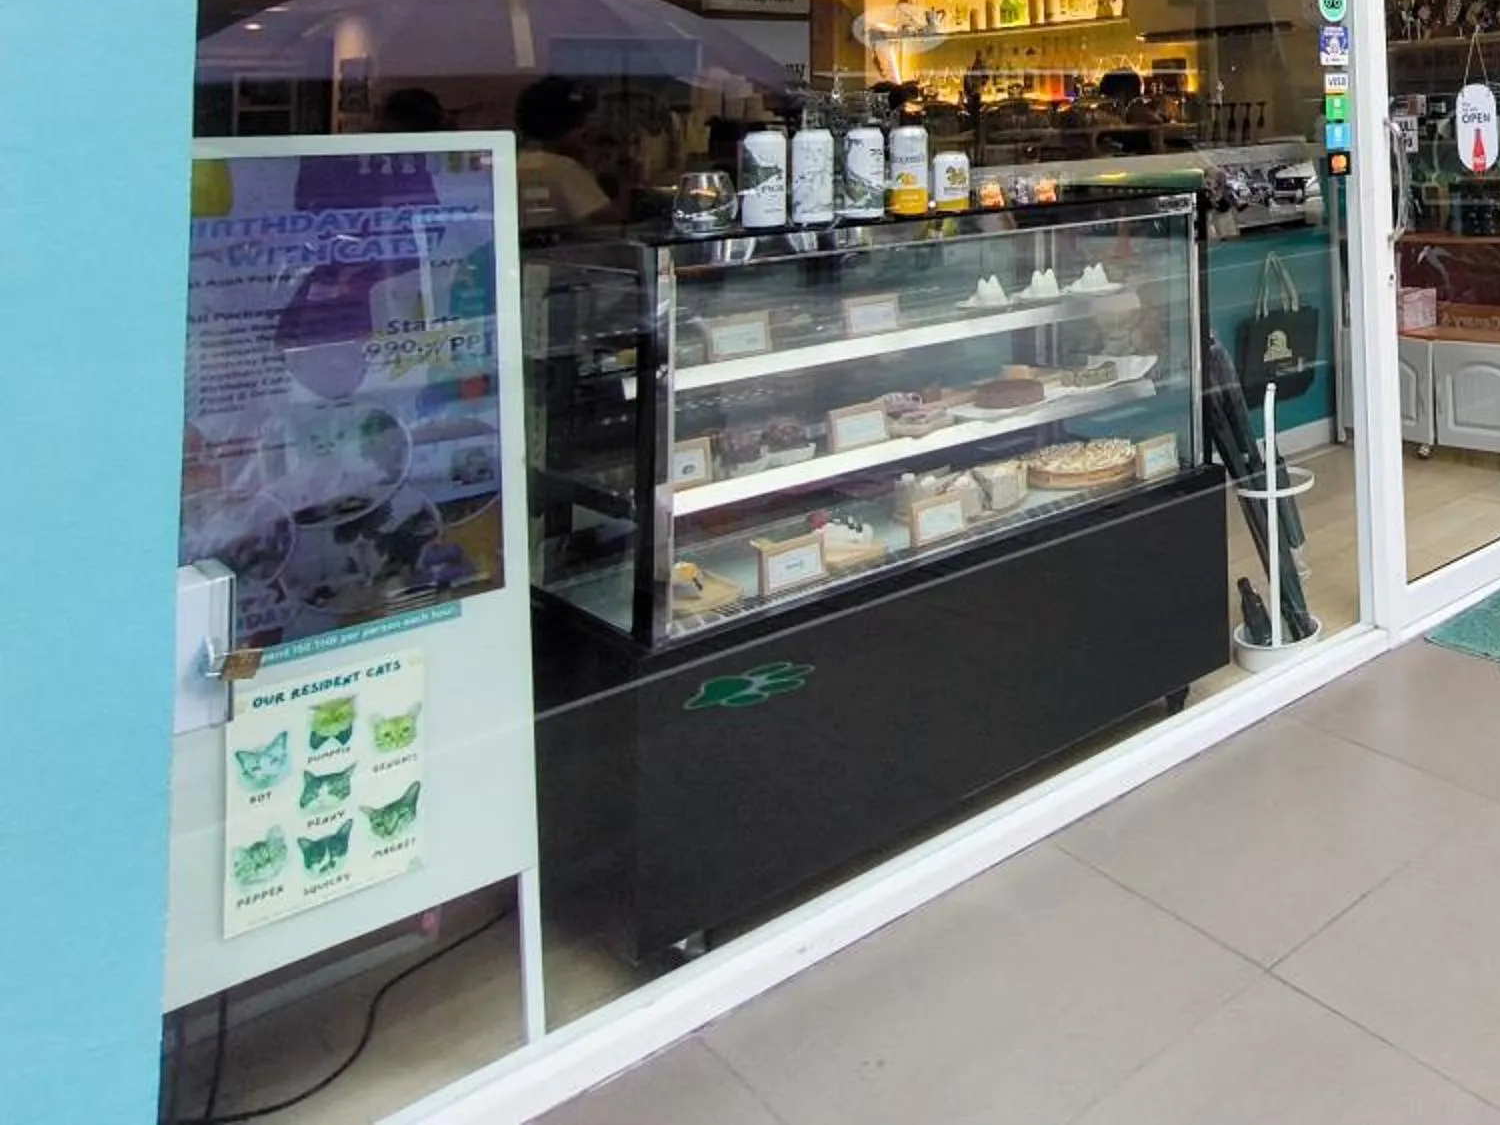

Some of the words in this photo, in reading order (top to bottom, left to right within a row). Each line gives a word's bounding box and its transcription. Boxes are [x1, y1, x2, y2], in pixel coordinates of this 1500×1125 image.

[1461, 112, 1491, 124] OPEN
[252, 692, 285, 709] OUR
[291, 670, 361, 701] RESIDENT
[365, 659, 402, 678] CATS
